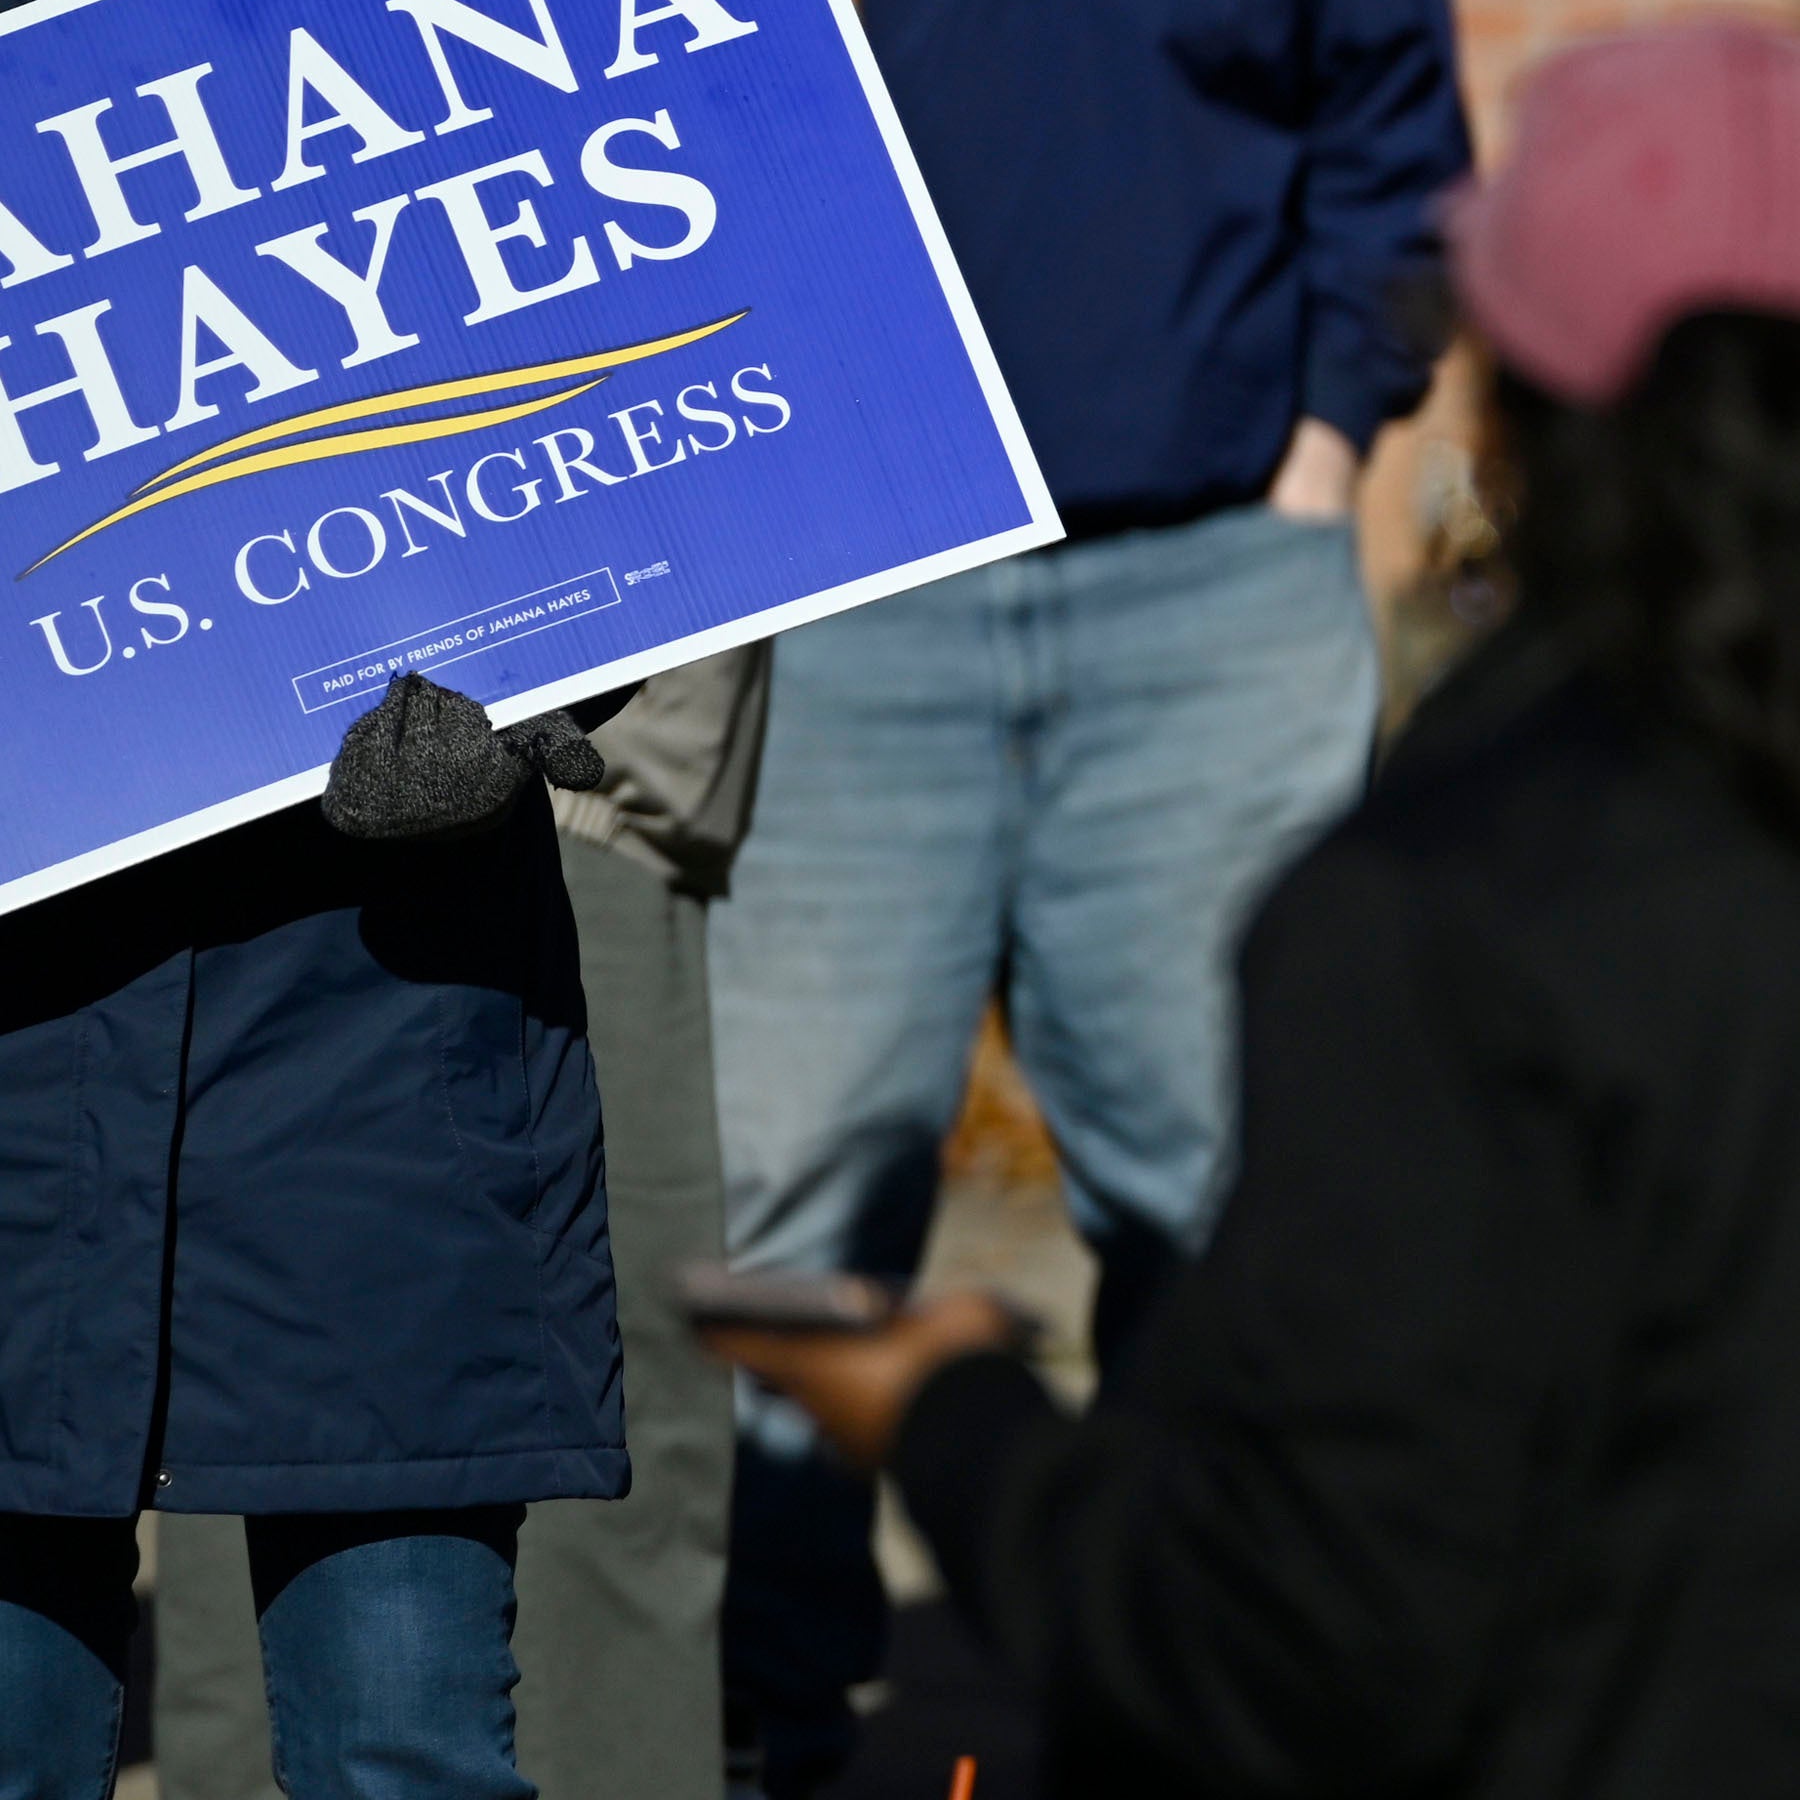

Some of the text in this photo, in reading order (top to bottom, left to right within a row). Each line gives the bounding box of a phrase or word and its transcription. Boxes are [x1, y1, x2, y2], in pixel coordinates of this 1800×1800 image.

[0, 109, 718, 493] HAYES
[30, 363, 791, 677] U.S. CONGRESS
[323, 589, 591, 693] PAID FOR BY FRIENDS OF JAHANA HAYES
